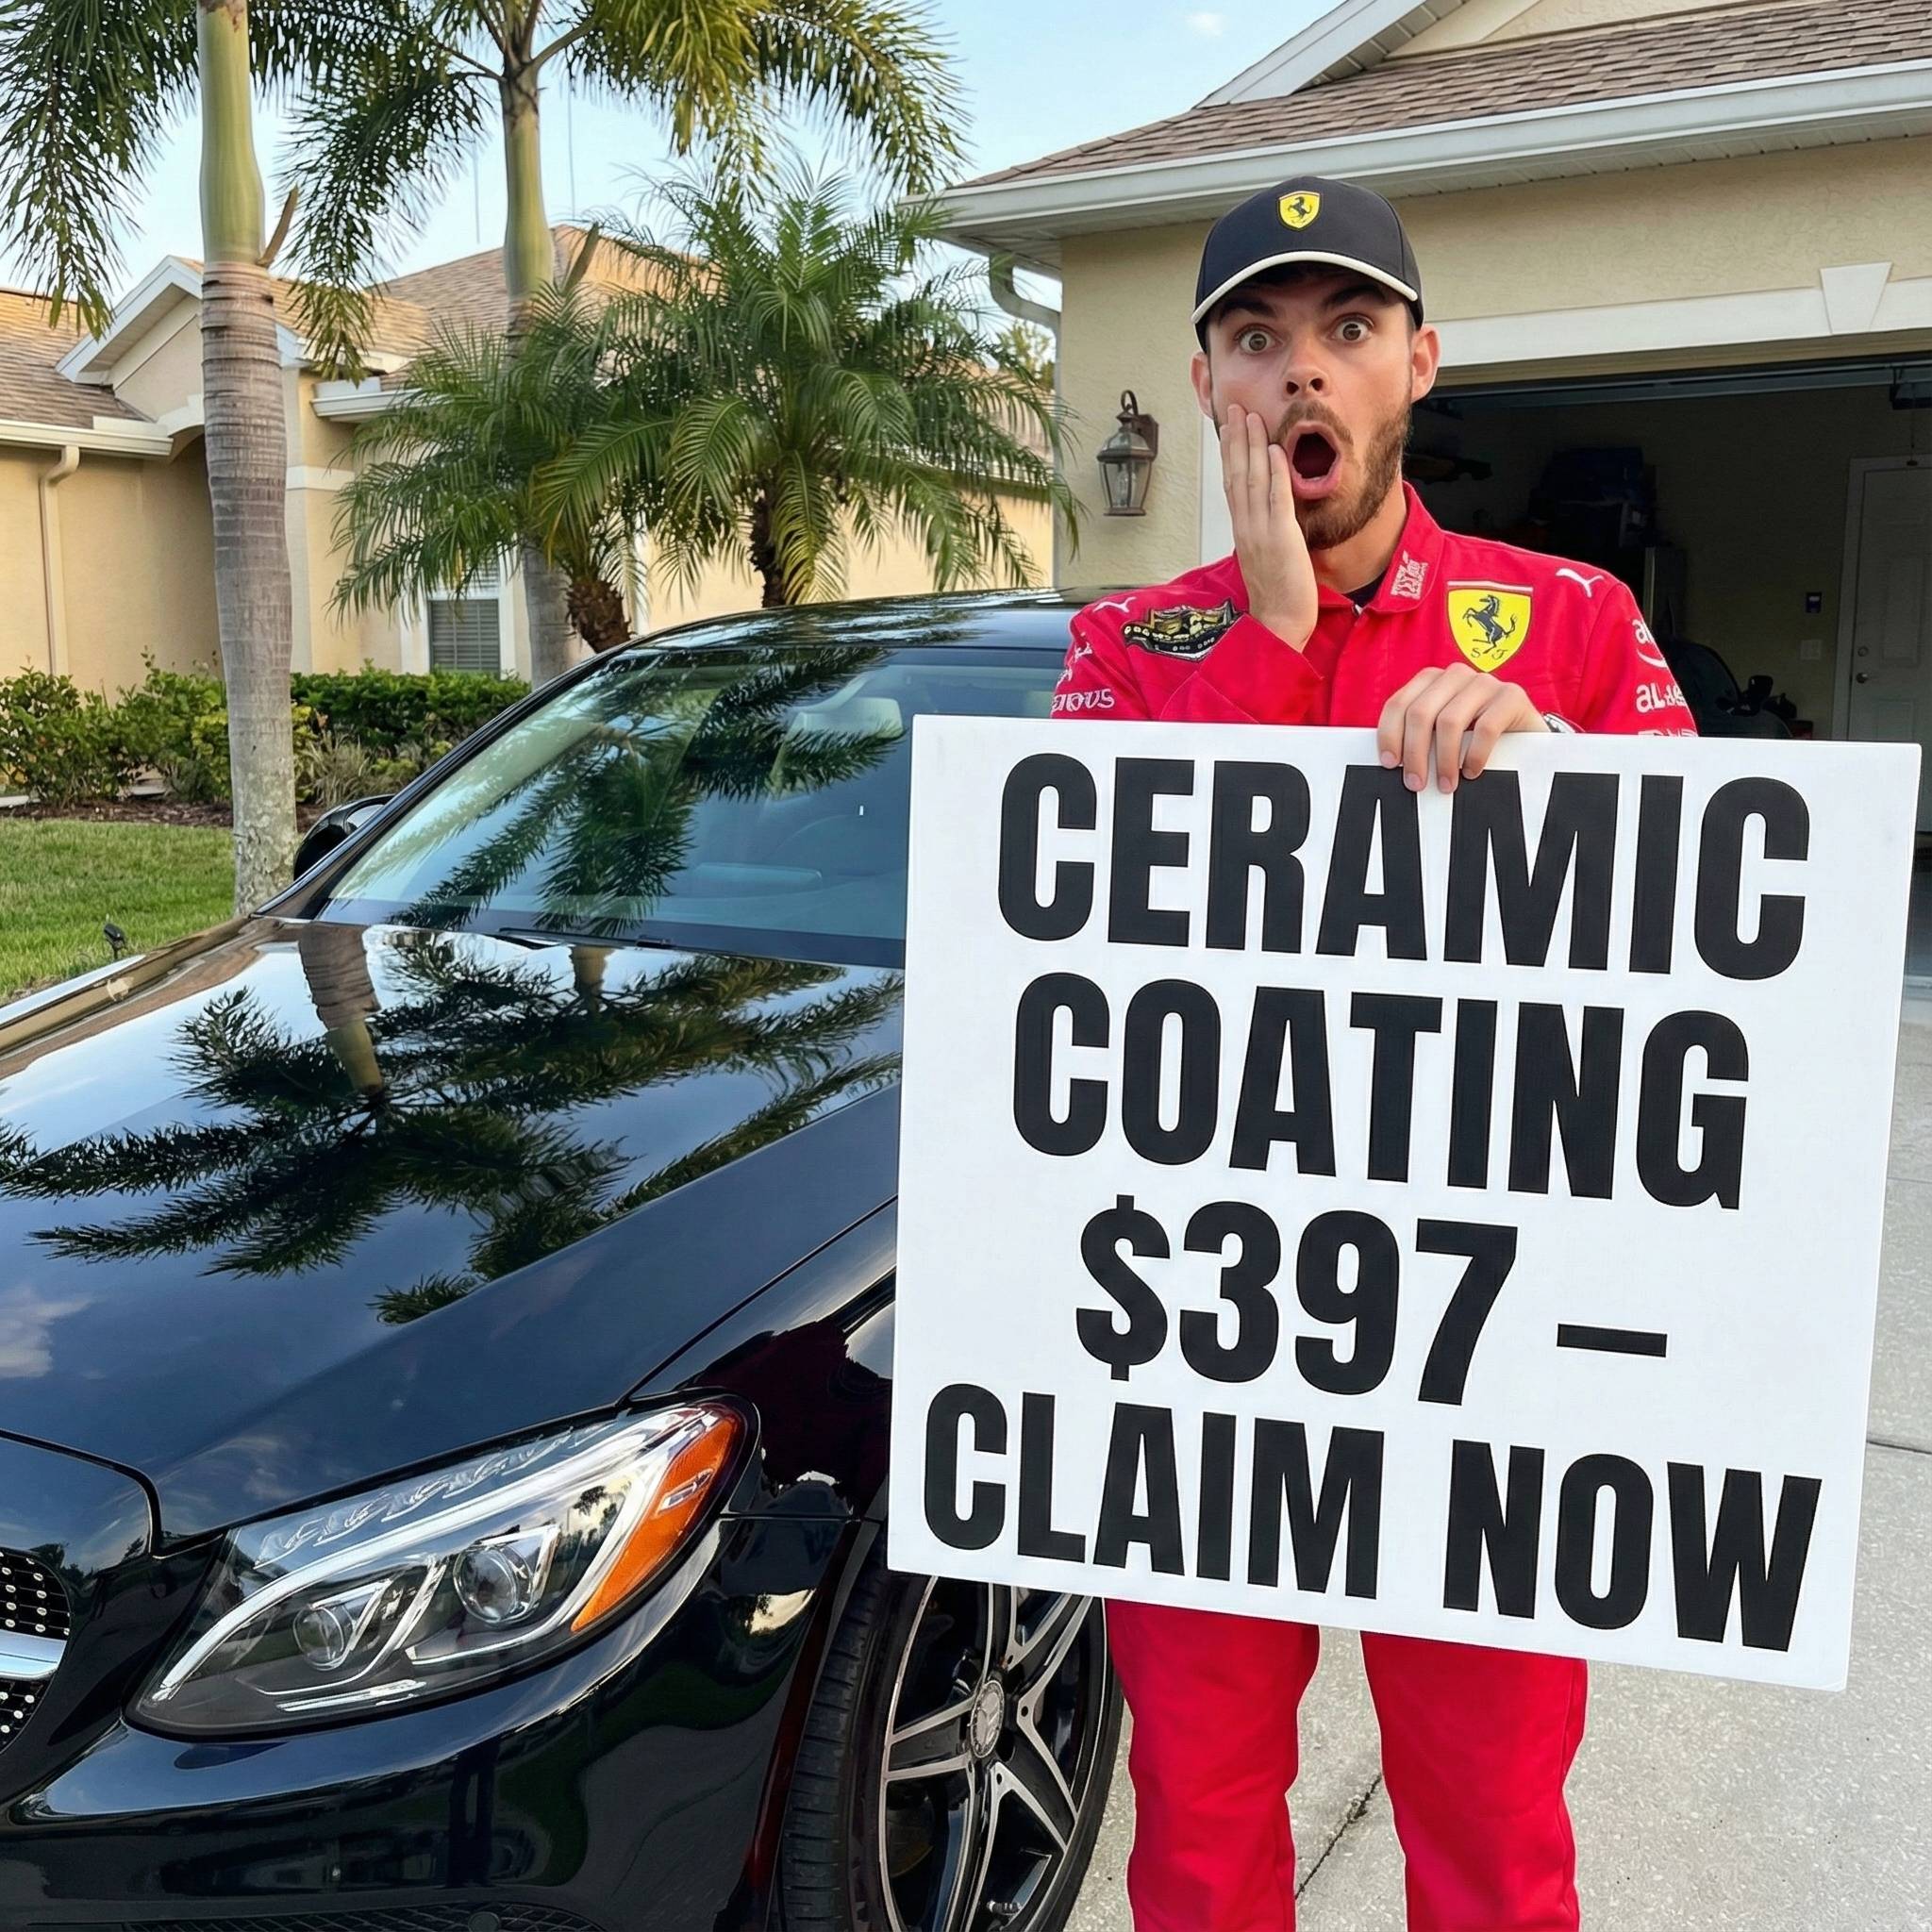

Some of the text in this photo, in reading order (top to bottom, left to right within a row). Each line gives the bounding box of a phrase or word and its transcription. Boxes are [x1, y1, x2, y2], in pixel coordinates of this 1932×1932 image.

[998, 752, 1809, 981] CERAMIC
[1014, 972, 1749, 1210] COATING
[1076, 1194, 1517, 1407] $397
[924, 1383, 1822, 1653] CLAIM NOW
